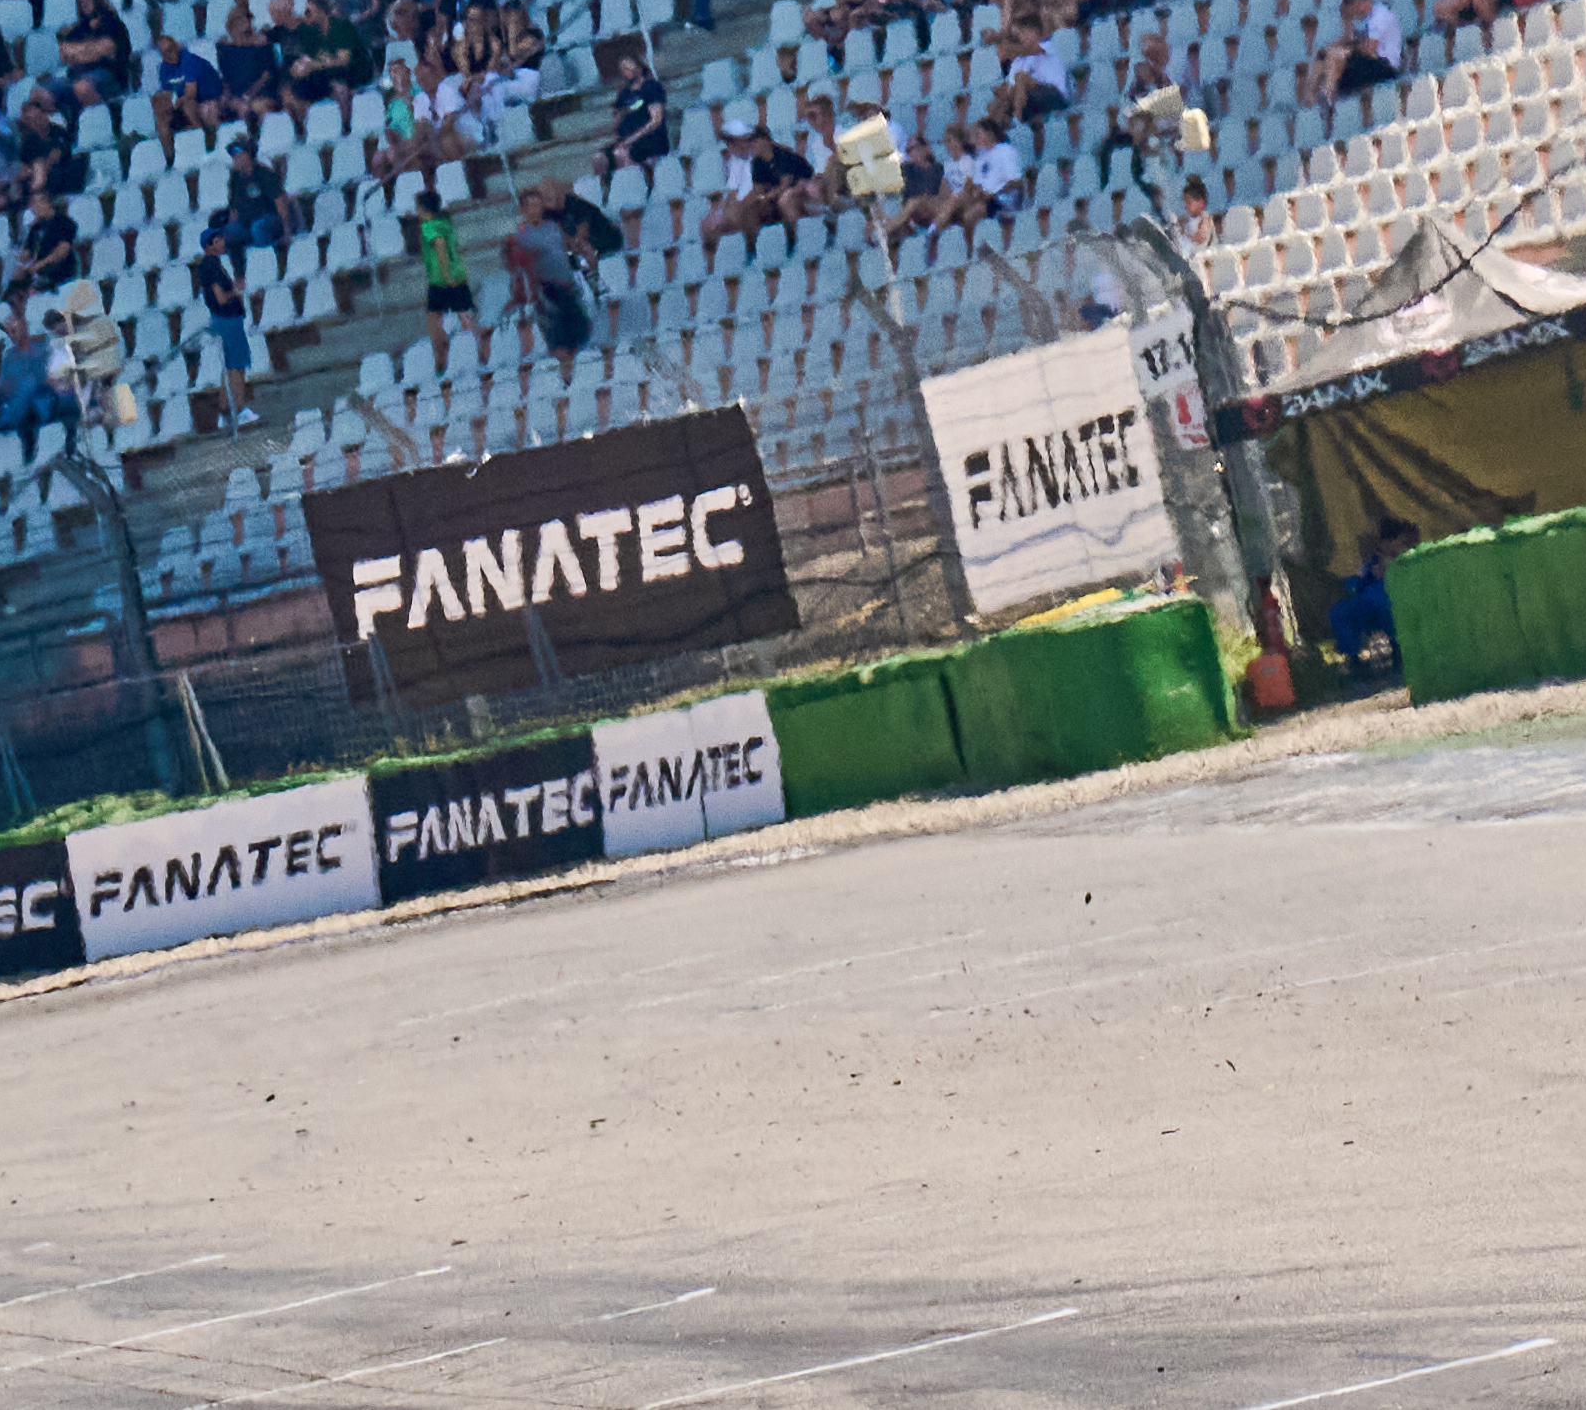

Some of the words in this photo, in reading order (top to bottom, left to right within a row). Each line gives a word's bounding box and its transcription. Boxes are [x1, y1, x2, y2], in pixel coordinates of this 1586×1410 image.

[963, 406, 1140, 529] FANATEC
[352, 484, 744, 640] FANATEC
[386, 772, 598, 864] FANATEC
[609, 737, 764, 812] FANATEC
[89, 822, 345, 918] FANATEC
